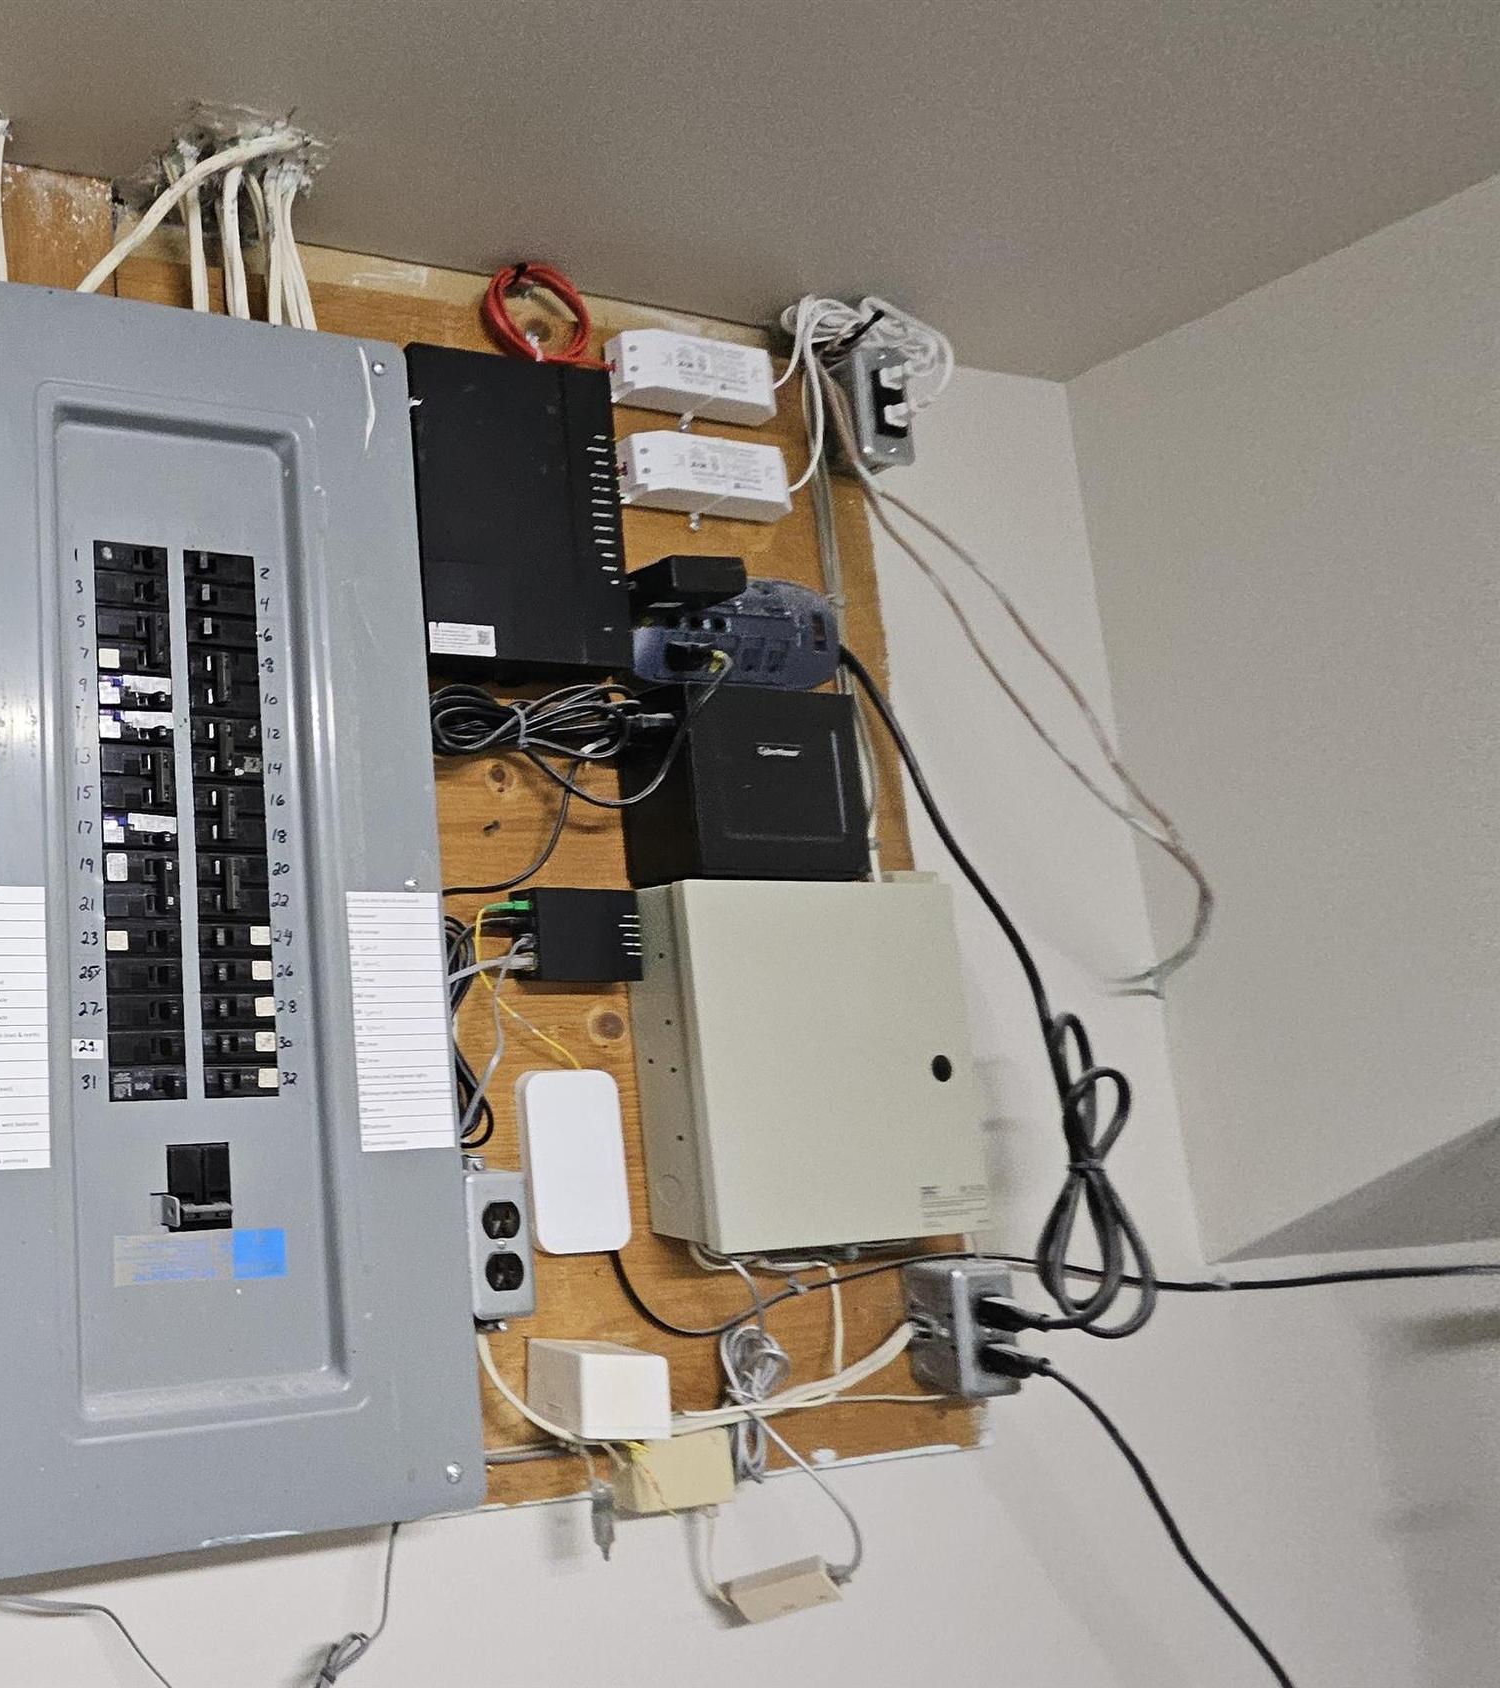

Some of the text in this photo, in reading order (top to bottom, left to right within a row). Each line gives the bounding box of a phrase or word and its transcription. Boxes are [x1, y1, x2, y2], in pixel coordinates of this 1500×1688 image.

[260, 568, 270, 579] 2
[76, 580, 83, 593] 3
[260, 597, 270, 611] 4
[76, 615, 85, 627] 5
[262, 629, 273, 642] 6
[80, 648, 89, 659] 7
[79, 678, 87, 691] 9
[264, 694, 278, 705] 10
[267, 728, 280, 739] 12
[268, 763, 282, 775] 14
[77, 785, 94, 800] 15
[269, 794, 285, 806] 16
[78, 821, 93, 834] 17
[272, 829, 287, 843] 18
[80, 858, 94, 872] 19
[272, 863, 290, 875] 20
[79, 897, 94, 911] 21
[271, 894, 289, 907] 22
[81, 931, 99, 946] 23
[274, 929, 292, 946] 24
[276, 965, 294, 977] 26
[277, 1000, 297, 1013] 28
[279, 1037, 297, 1048] 30
[81, 1074, 97, 1090] 31
[282, 1073, 298, 1086] 32
